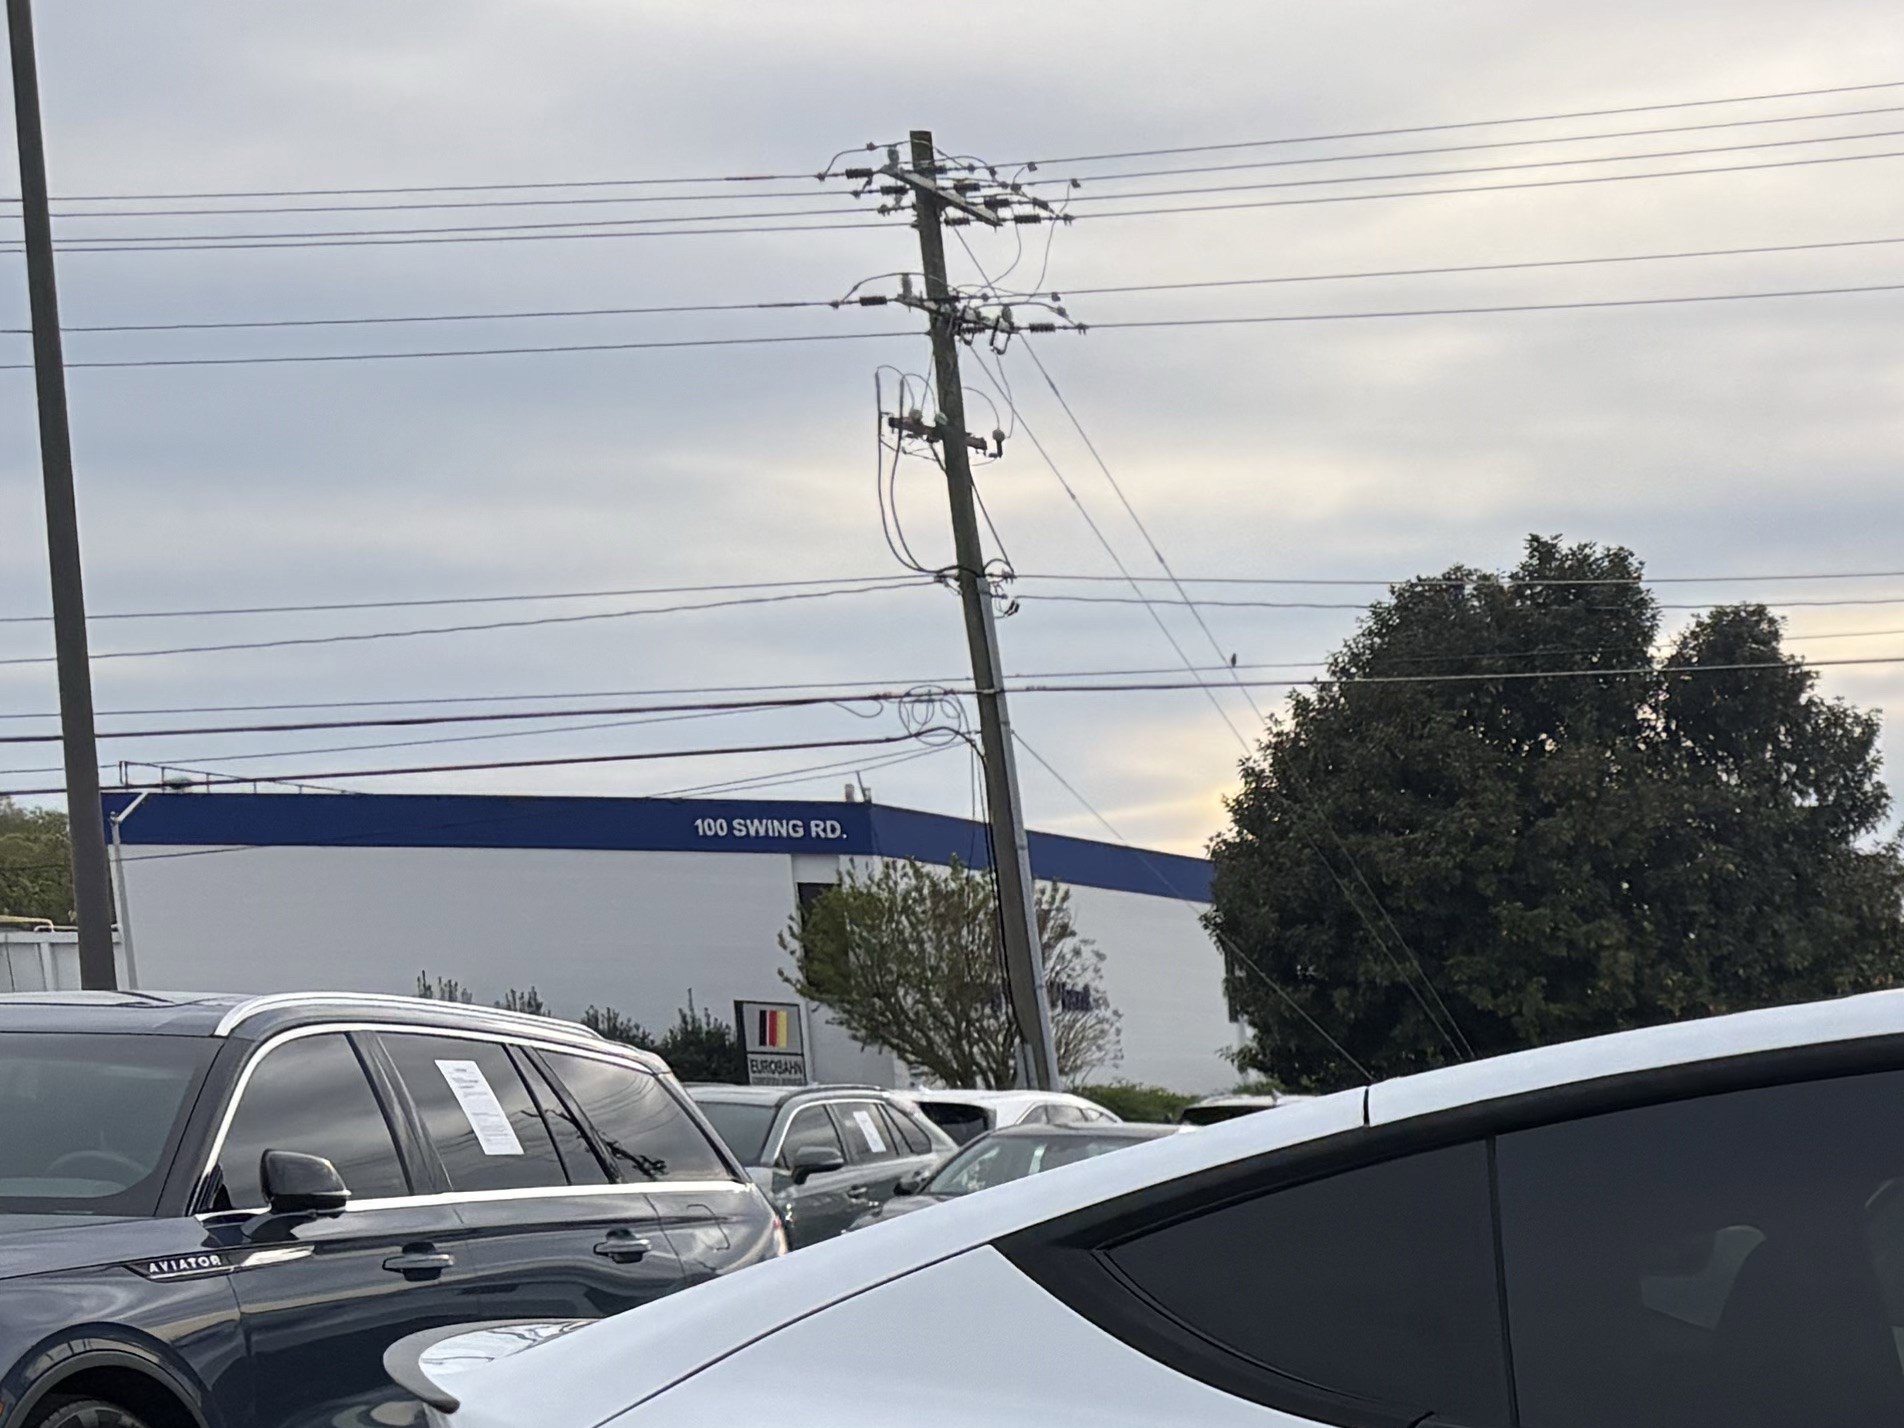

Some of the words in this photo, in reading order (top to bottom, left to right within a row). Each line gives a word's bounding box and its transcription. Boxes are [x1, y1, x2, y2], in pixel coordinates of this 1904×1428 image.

[694, 818, 728, 836] 100
[732, 818, 805, 838] SWING
[810, 820, 847, 839] RD.
[149, 1255, 221, 1273] AVIATOR
